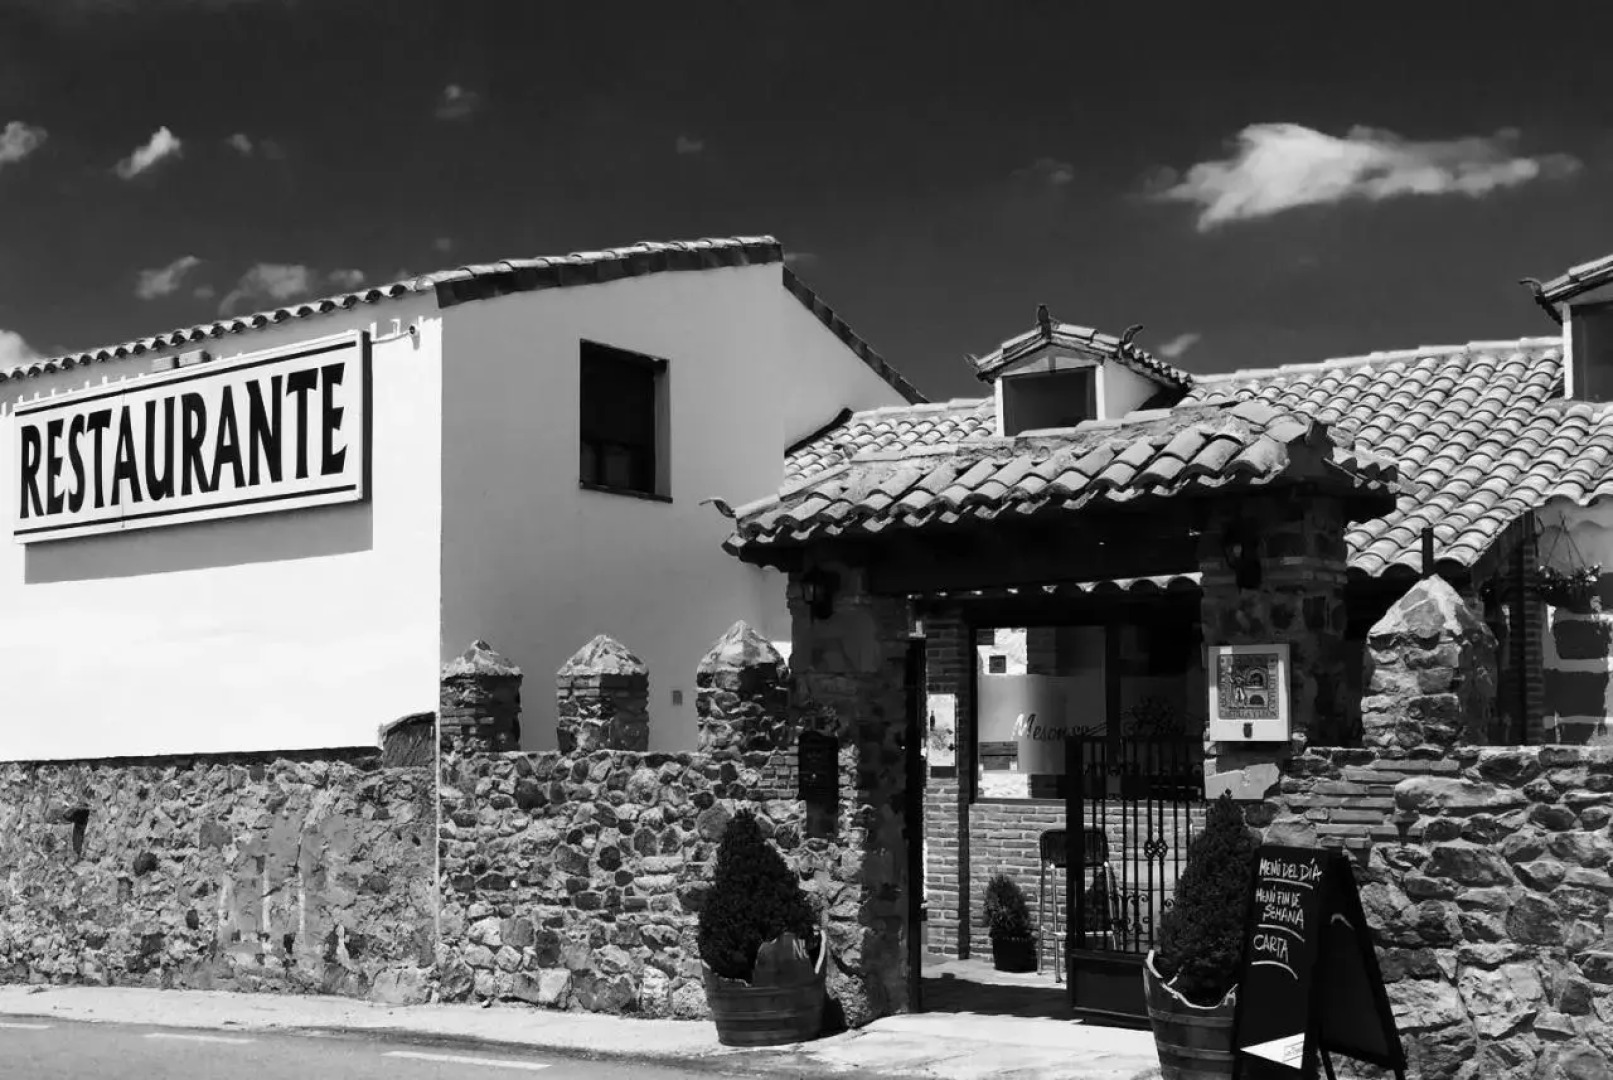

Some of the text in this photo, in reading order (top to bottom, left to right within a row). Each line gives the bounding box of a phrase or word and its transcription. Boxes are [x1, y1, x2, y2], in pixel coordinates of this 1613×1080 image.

[20, 362, 347, 519] RESTAURANTE
[1282, 862, 1299, 879] DEL
[1299, 857, 1323, 882] DÍA
[1262, 903, 1305, 929] SEMANA
[1253, 933, 1289, 964] CARTA
